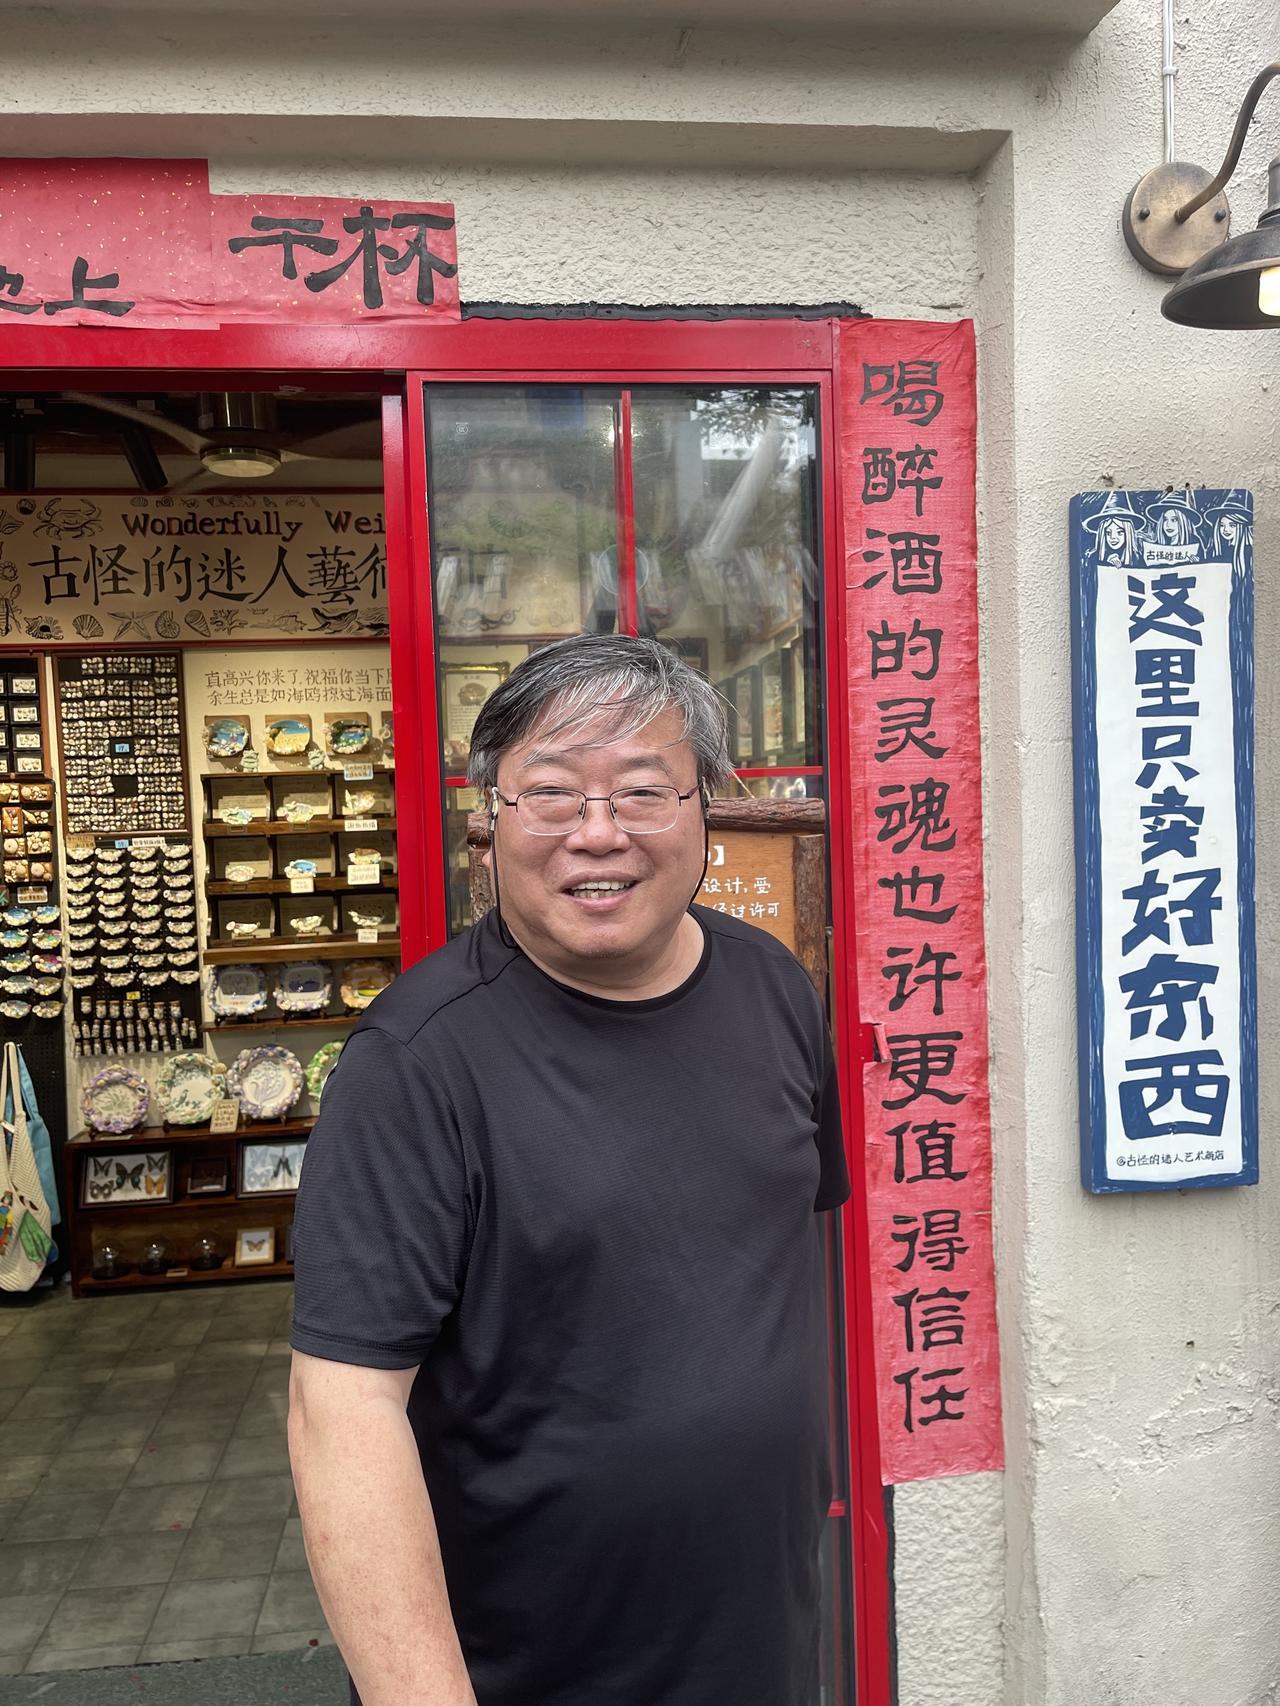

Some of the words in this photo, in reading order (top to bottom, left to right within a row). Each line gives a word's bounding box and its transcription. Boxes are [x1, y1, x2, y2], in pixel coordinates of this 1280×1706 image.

[229, 205, 458, 309] 干杯
[121, 510, 305, 542] Wonderfully
[861, 361, 968, 1434] 喝醉酒的灵魂也许更值得信任
[1119, 572, 1231, 1139] 这里只卖好东西
